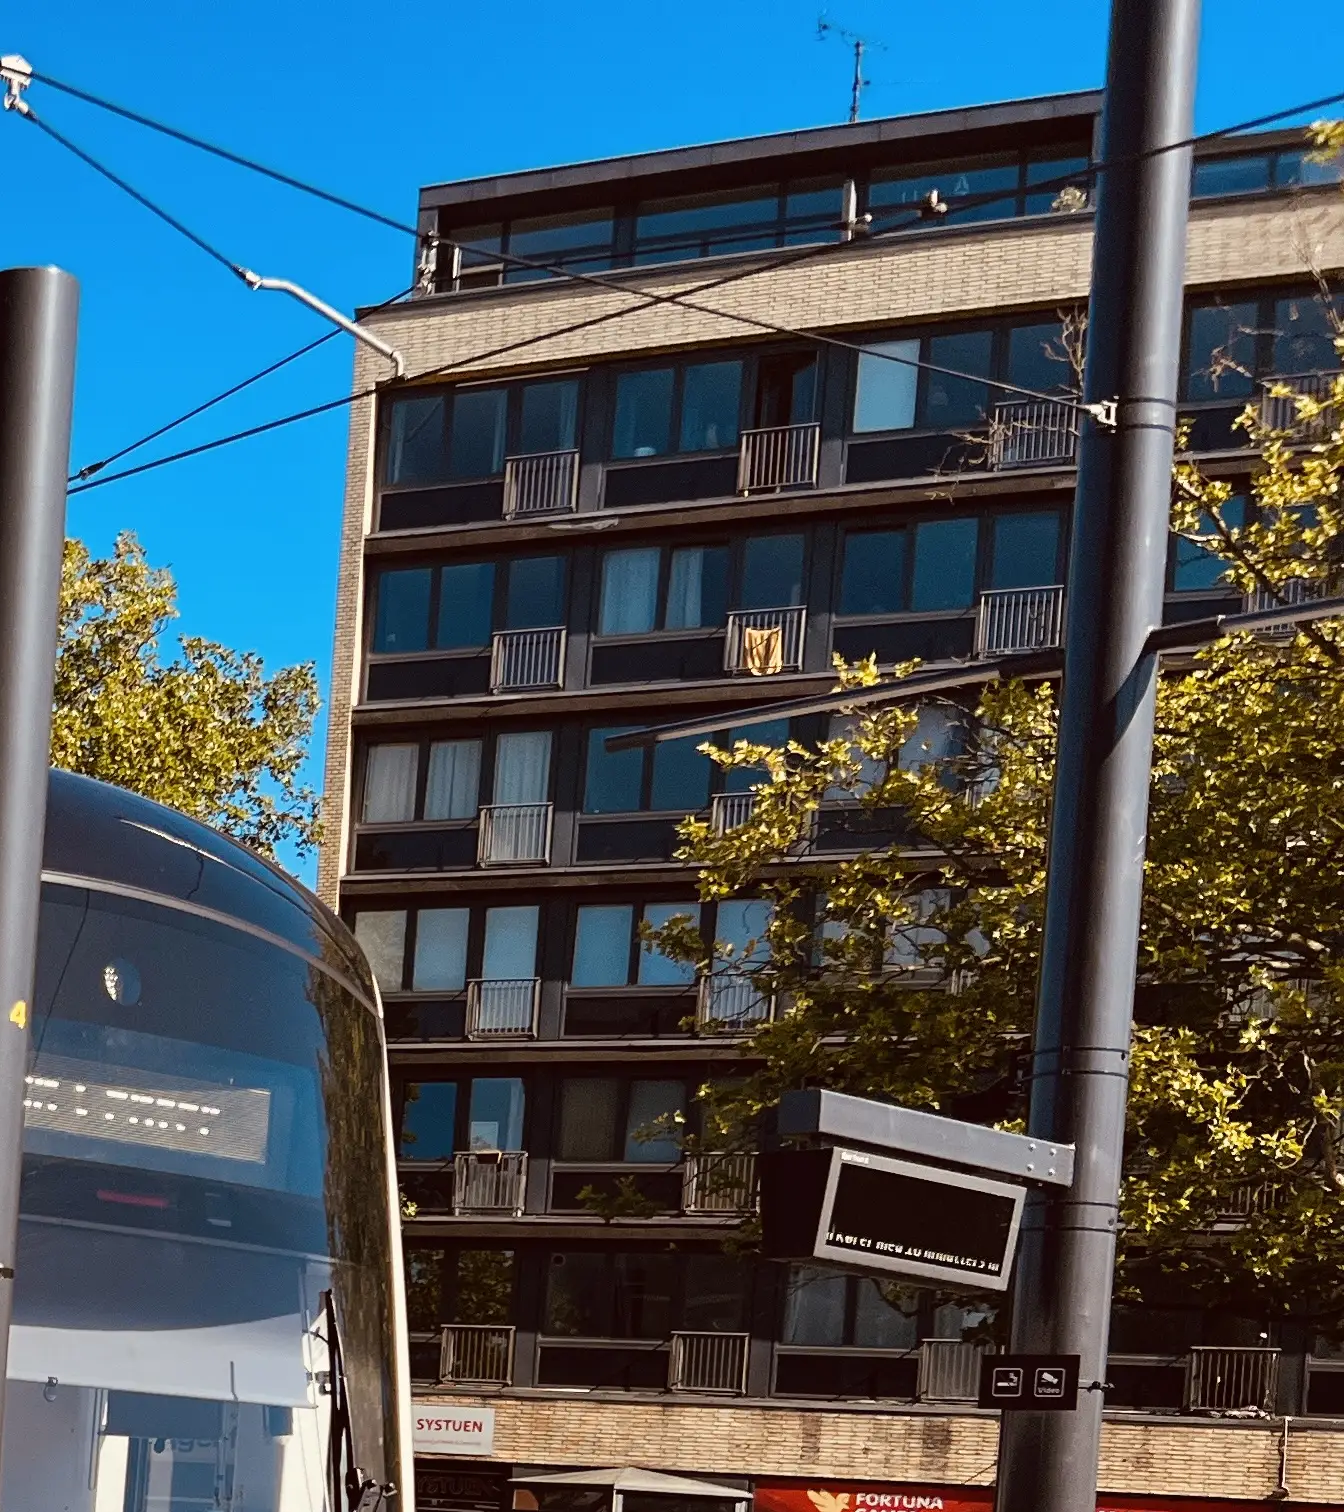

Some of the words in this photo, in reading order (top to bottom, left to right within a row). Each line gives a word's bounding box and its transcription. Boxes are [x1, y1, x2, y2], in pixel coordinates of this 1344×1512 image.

[9, 999, 27, 1030] 4
[415, 1418, 484, 1433] SYSTUEN
[416, 1475, 494, 1497] YSTUEN
[855, 1493, 944, 1510] FORTUNA
